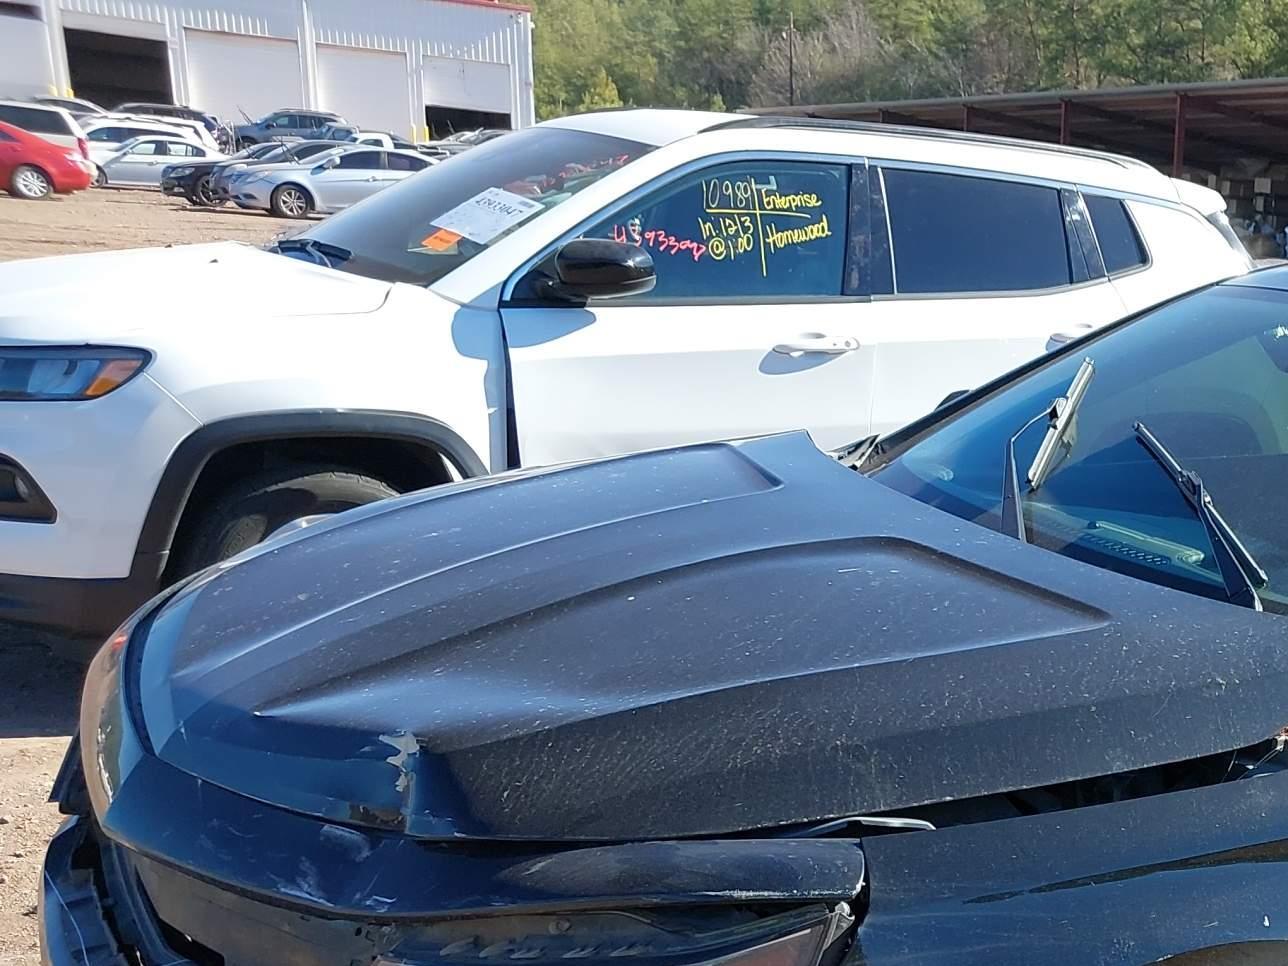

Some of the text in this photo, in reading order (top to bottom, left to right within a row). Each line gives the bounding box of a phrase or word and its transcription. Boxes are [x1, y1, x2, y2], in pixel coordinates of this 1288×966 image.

[761, 187, 822, 211] Enterprise
[765, 214, 832, 254] Homewood
[708, 237, 727, 260] @
